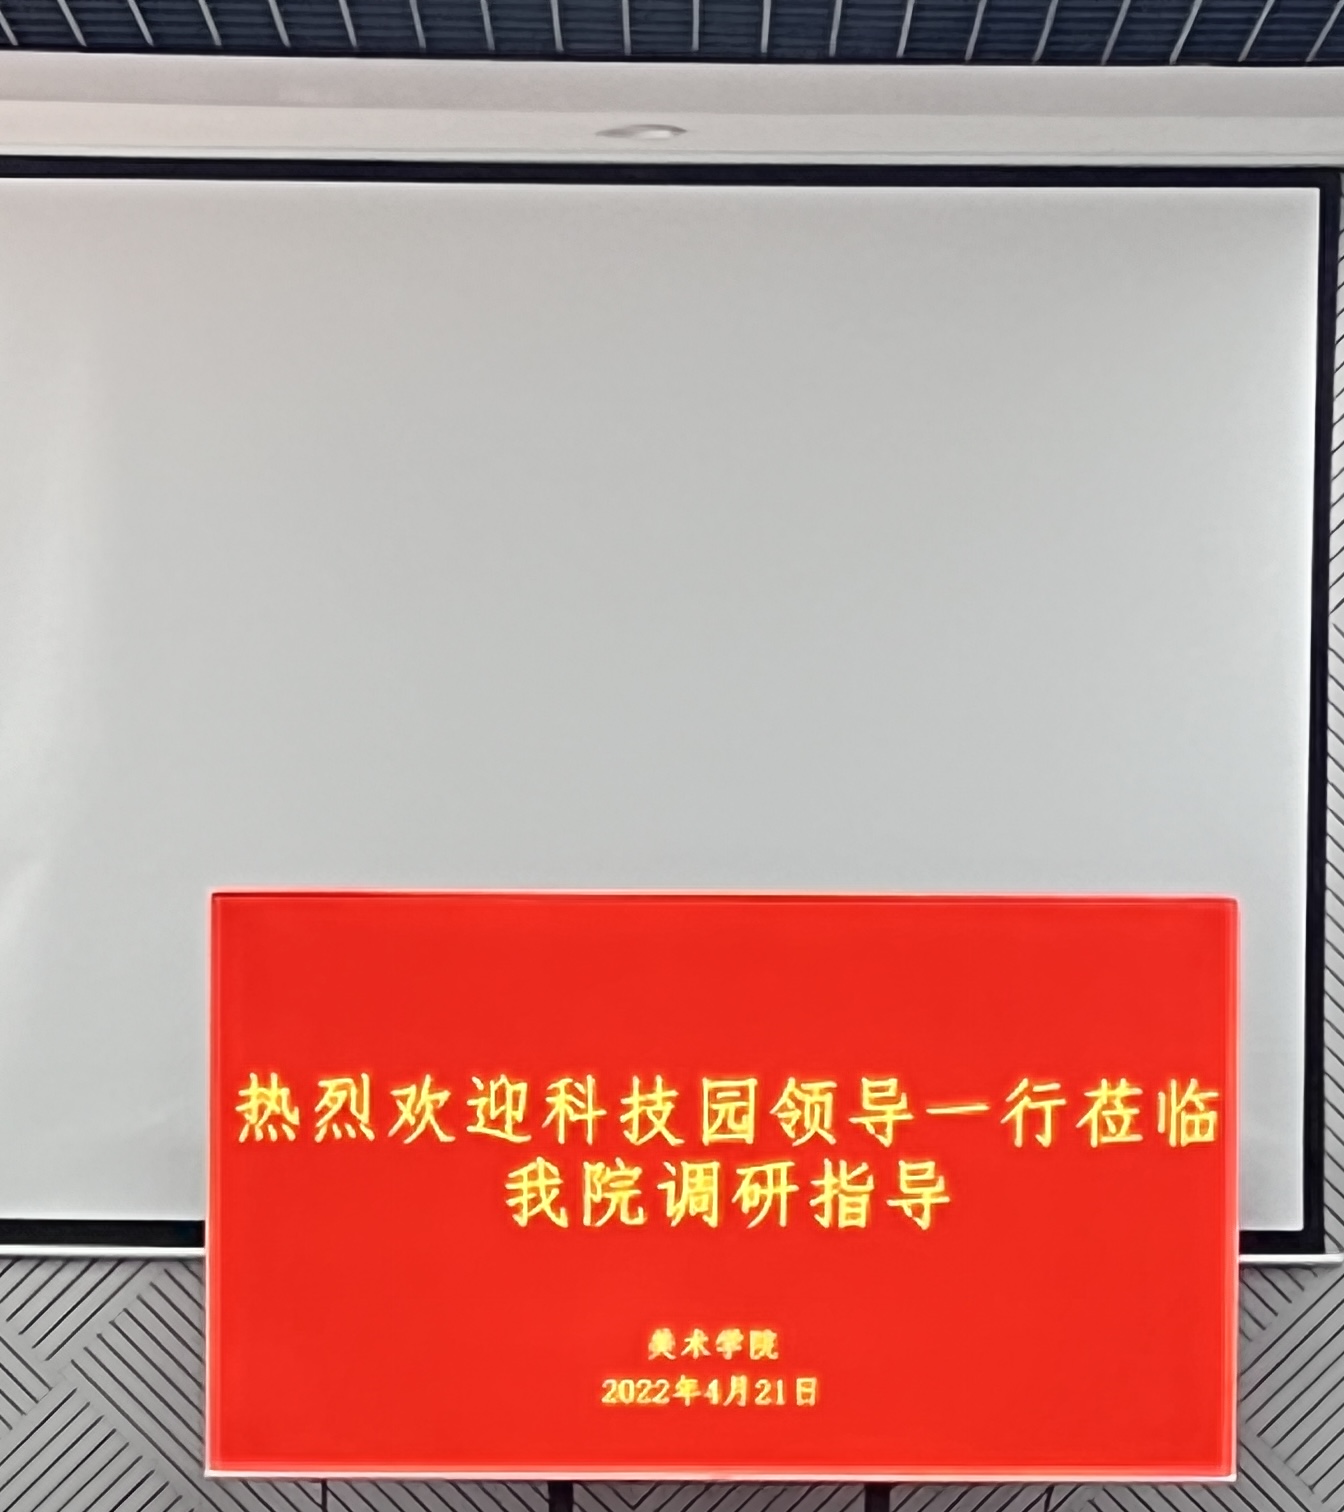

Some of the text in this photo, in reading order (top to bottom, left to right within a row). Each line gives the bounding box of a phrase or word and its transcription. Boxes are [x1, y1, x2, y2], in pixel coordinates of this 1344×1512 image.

[235, 1071, 1221, 1148] 热烈欢迎科技园领导一行莅临
[504, 1154, 951, 1230] 我院调研指导
[647, 1327, 779, 1360] 美术学院
[600, 1374, 818, 1407] 2022年4月21日
